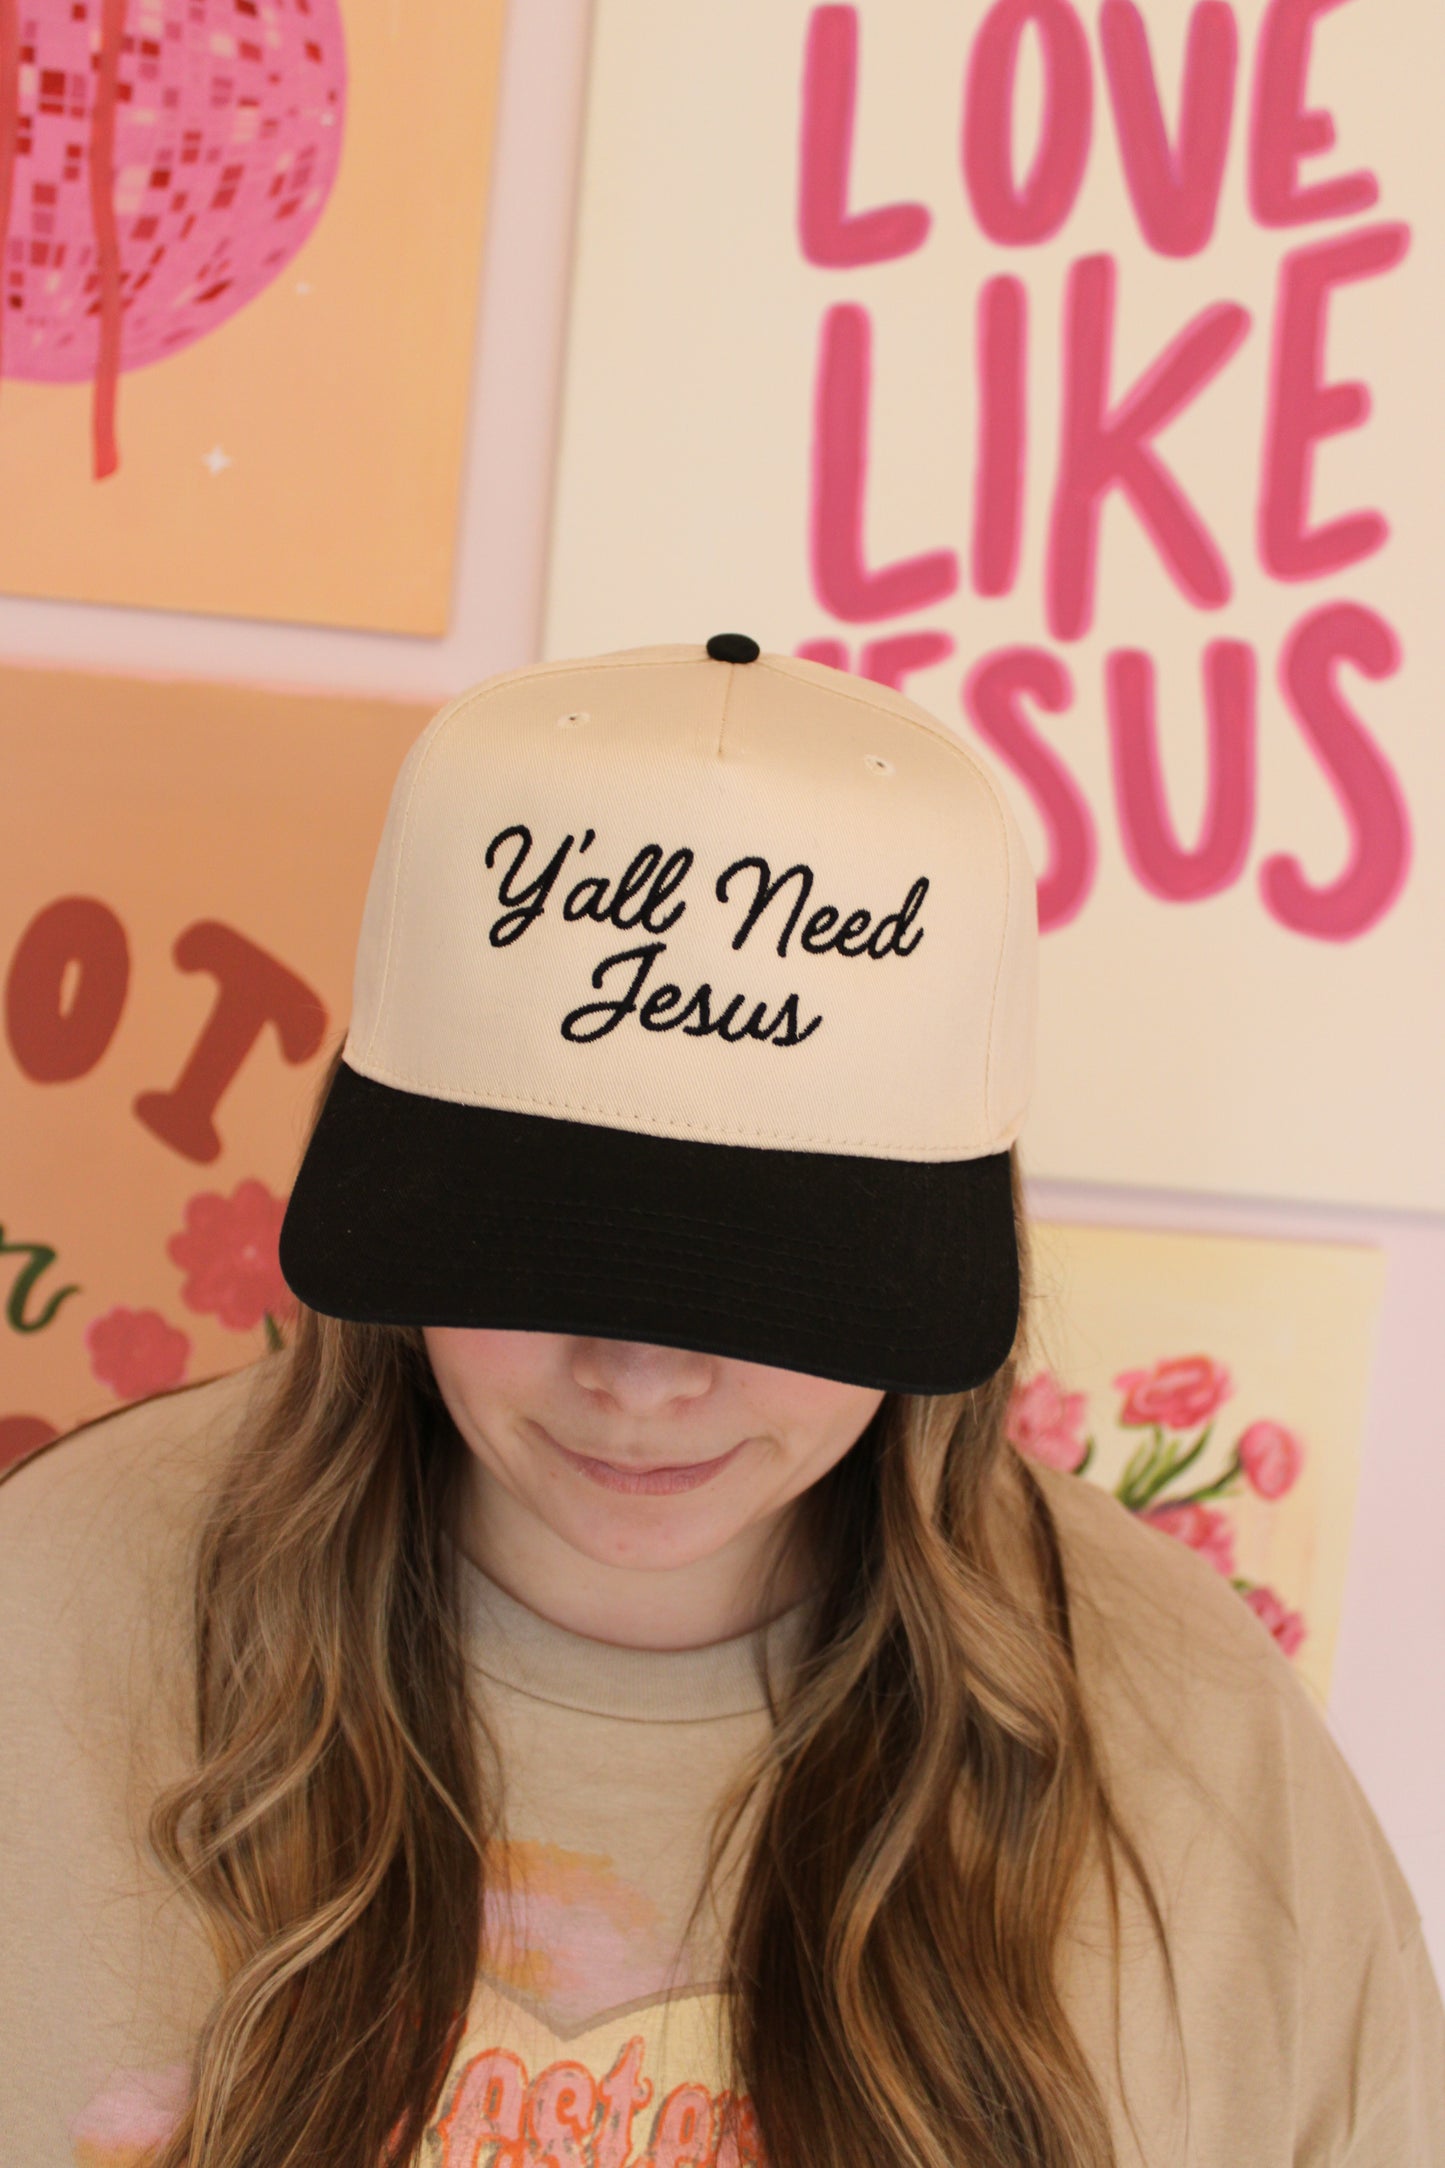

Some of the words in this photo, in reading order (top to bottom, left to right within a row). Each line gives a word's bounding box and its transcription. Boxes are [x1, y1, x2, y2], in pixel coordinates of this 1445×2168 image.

[797, 0, 1382, 269] LOVE
[809, 221, 1411, 643] LIKE
[485, 824, 694, 948] Y'all
[715, 856, 930, 959] Need
[796, 600, 1413, 945] SUS
[560, 942, 823, 1046] Jesus
